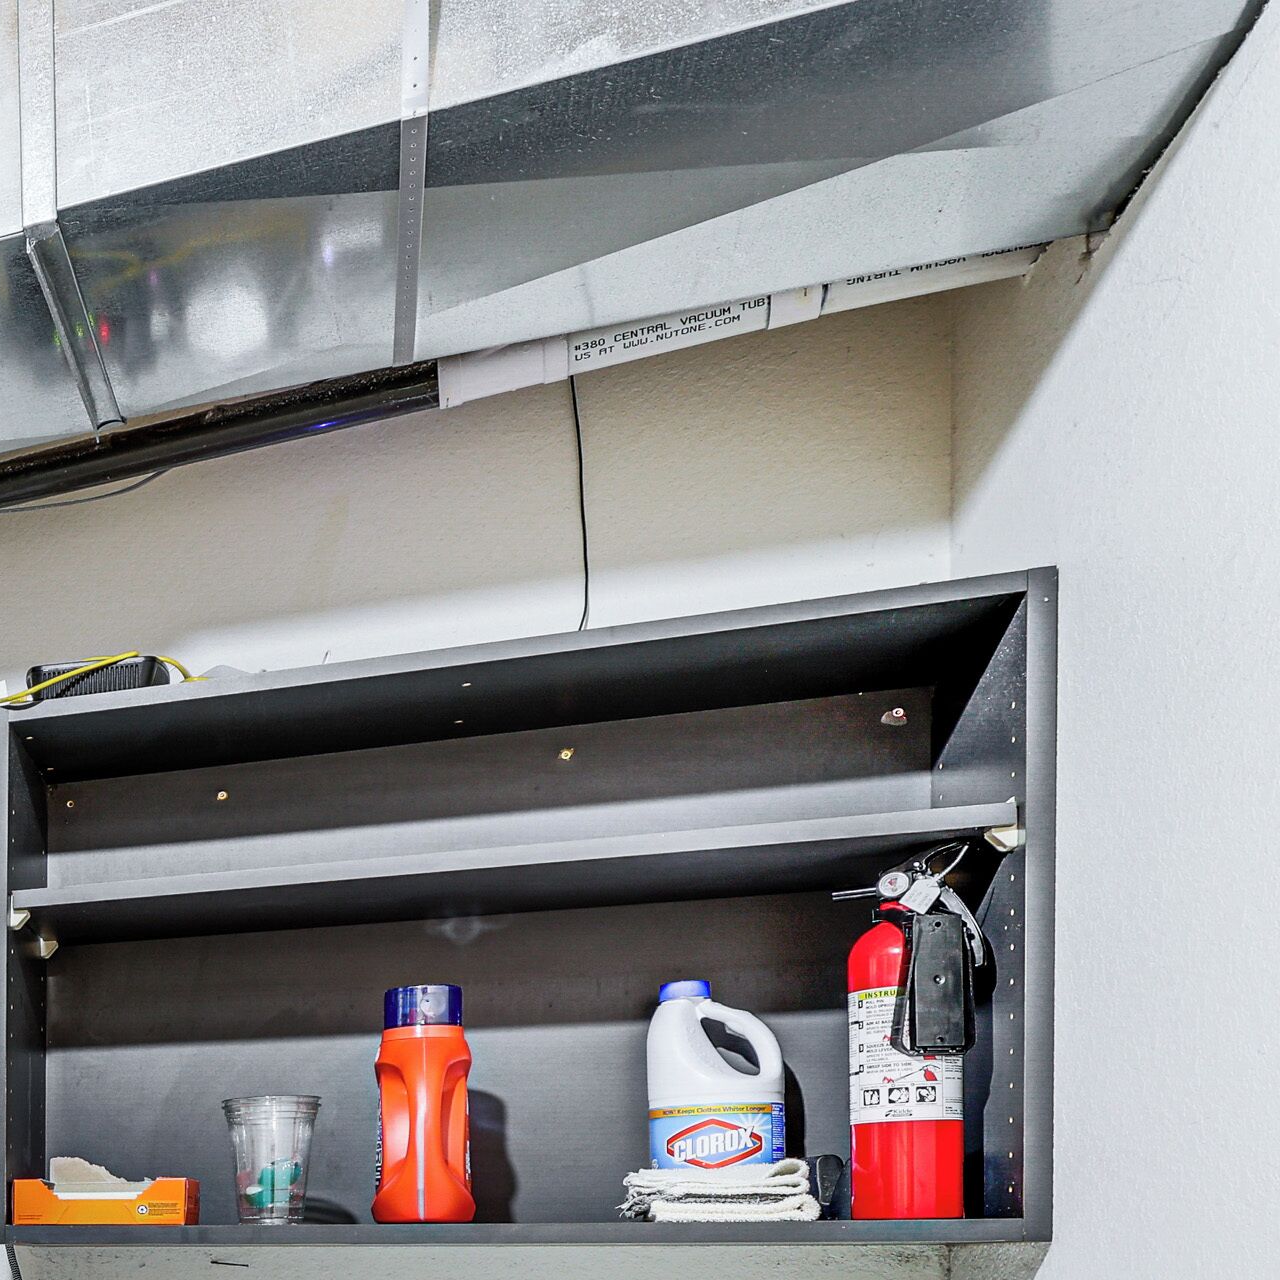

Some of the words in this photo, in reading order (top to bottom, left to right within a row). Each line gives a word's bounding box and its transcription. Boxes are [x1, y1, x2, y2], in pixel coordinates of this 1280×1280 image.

[574, 338, 606, 352] #380
[614, 322, 673, 343] CENTRAL
[680, 306, 731, 326] VACUUM
[574, 351, 591, 362] US
[598, 345, 615, 356] AT
[622, 314, 741, 350] WWW.NUTONE.COM
[673, 1125, 755, 1162] CLOROX
